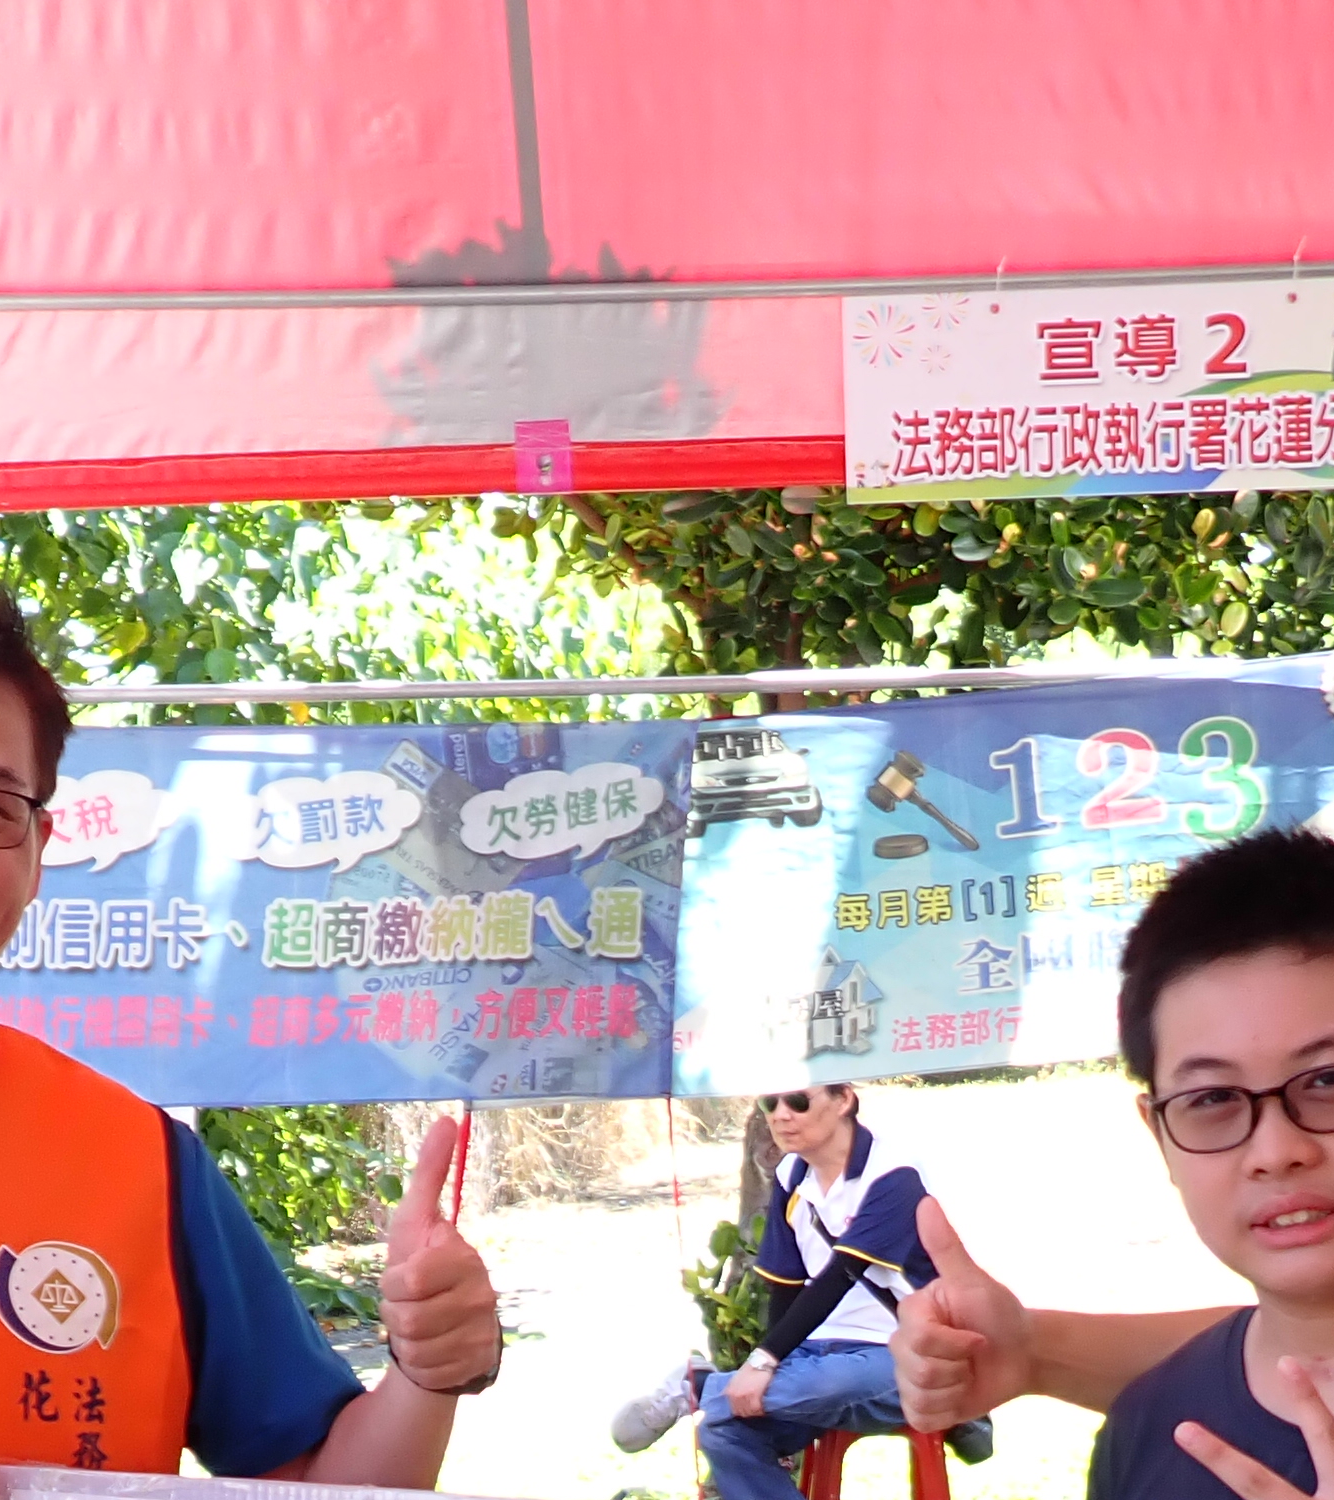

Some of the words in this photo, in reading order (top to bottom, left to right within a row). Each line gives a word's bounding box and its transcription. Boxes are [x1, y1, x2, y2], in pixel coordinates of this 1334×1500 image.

[1037, 313, 1177, 381] 宣導
[1204, 312, 1249, 376] 2
[256, 792, 385, 850] 欠罰款
[488, 778, 638, 847] 欠勞健保
[19, 1369, 60, 1421] 花
